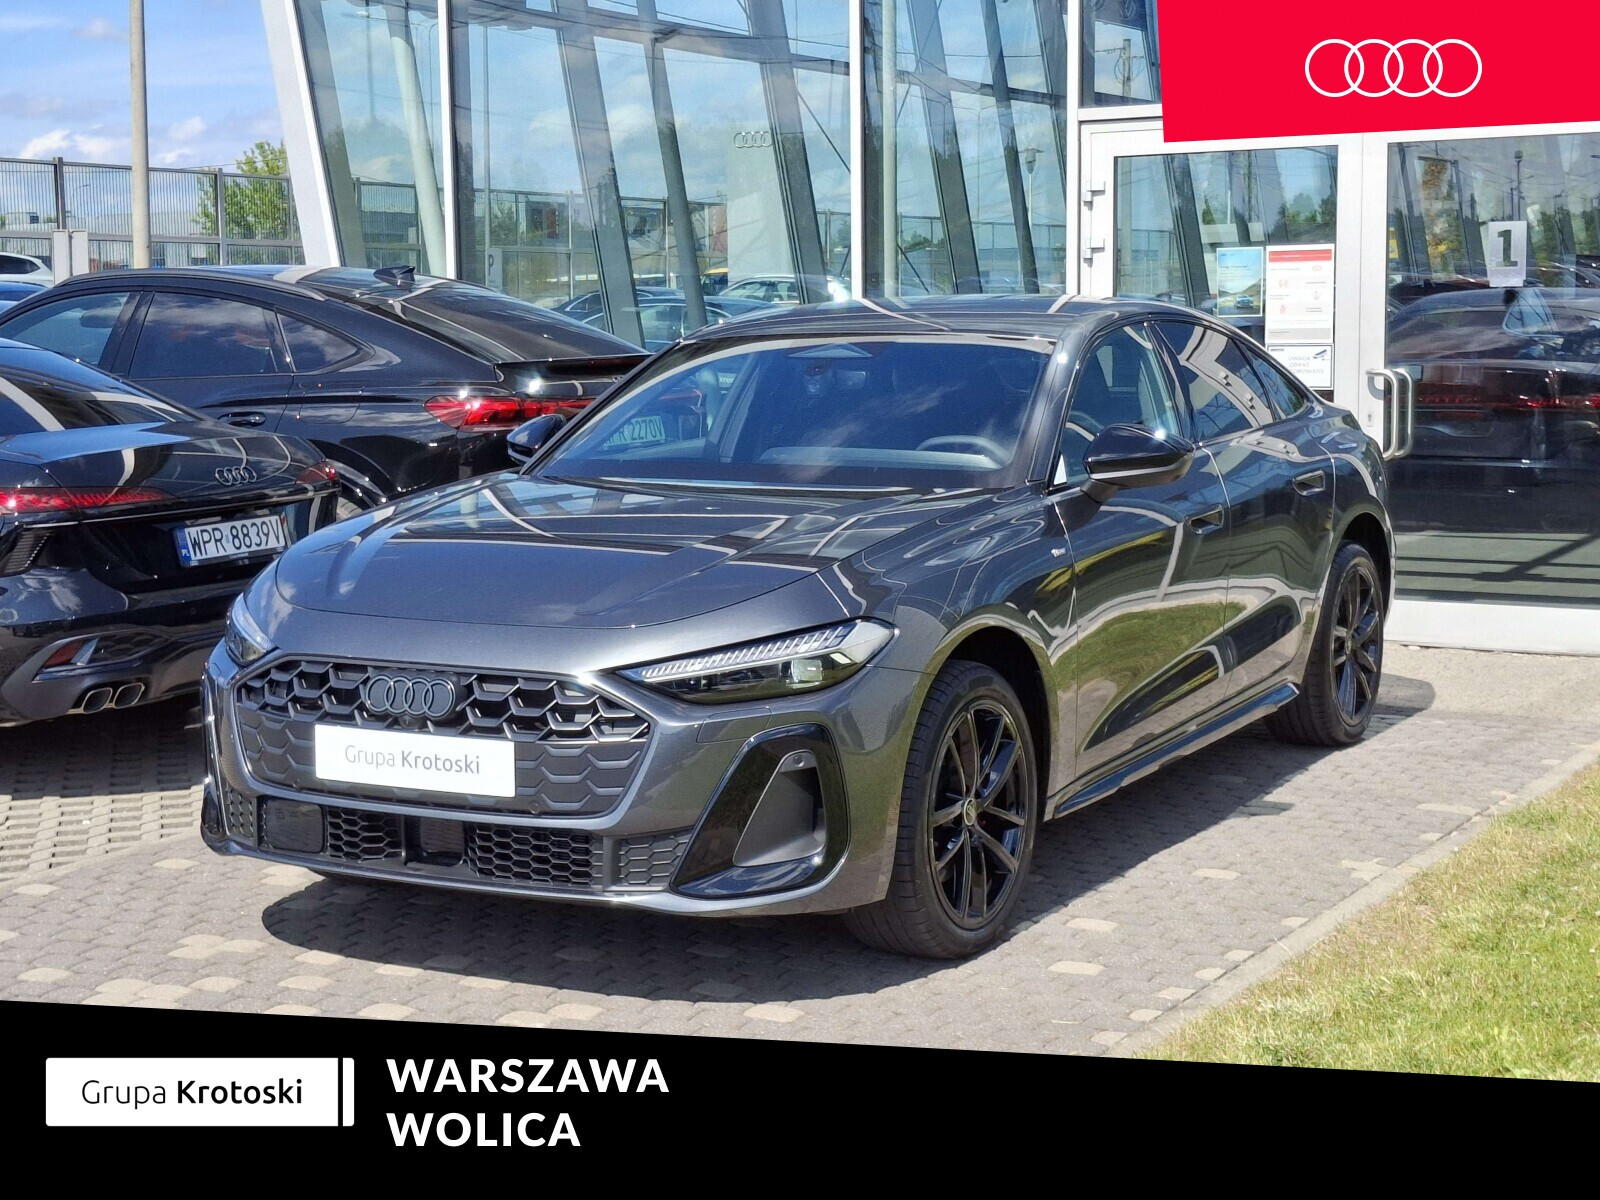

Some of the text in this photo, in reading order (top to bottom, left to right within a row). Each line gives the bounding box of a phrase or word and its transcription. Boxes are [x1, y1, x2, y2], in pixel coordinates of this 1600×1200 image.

[1496, 229, 1519, 268] 1
[188, 518, 280, 557] WPR 8839V
[344, 744, 481, 775] Grupa Krotoski
